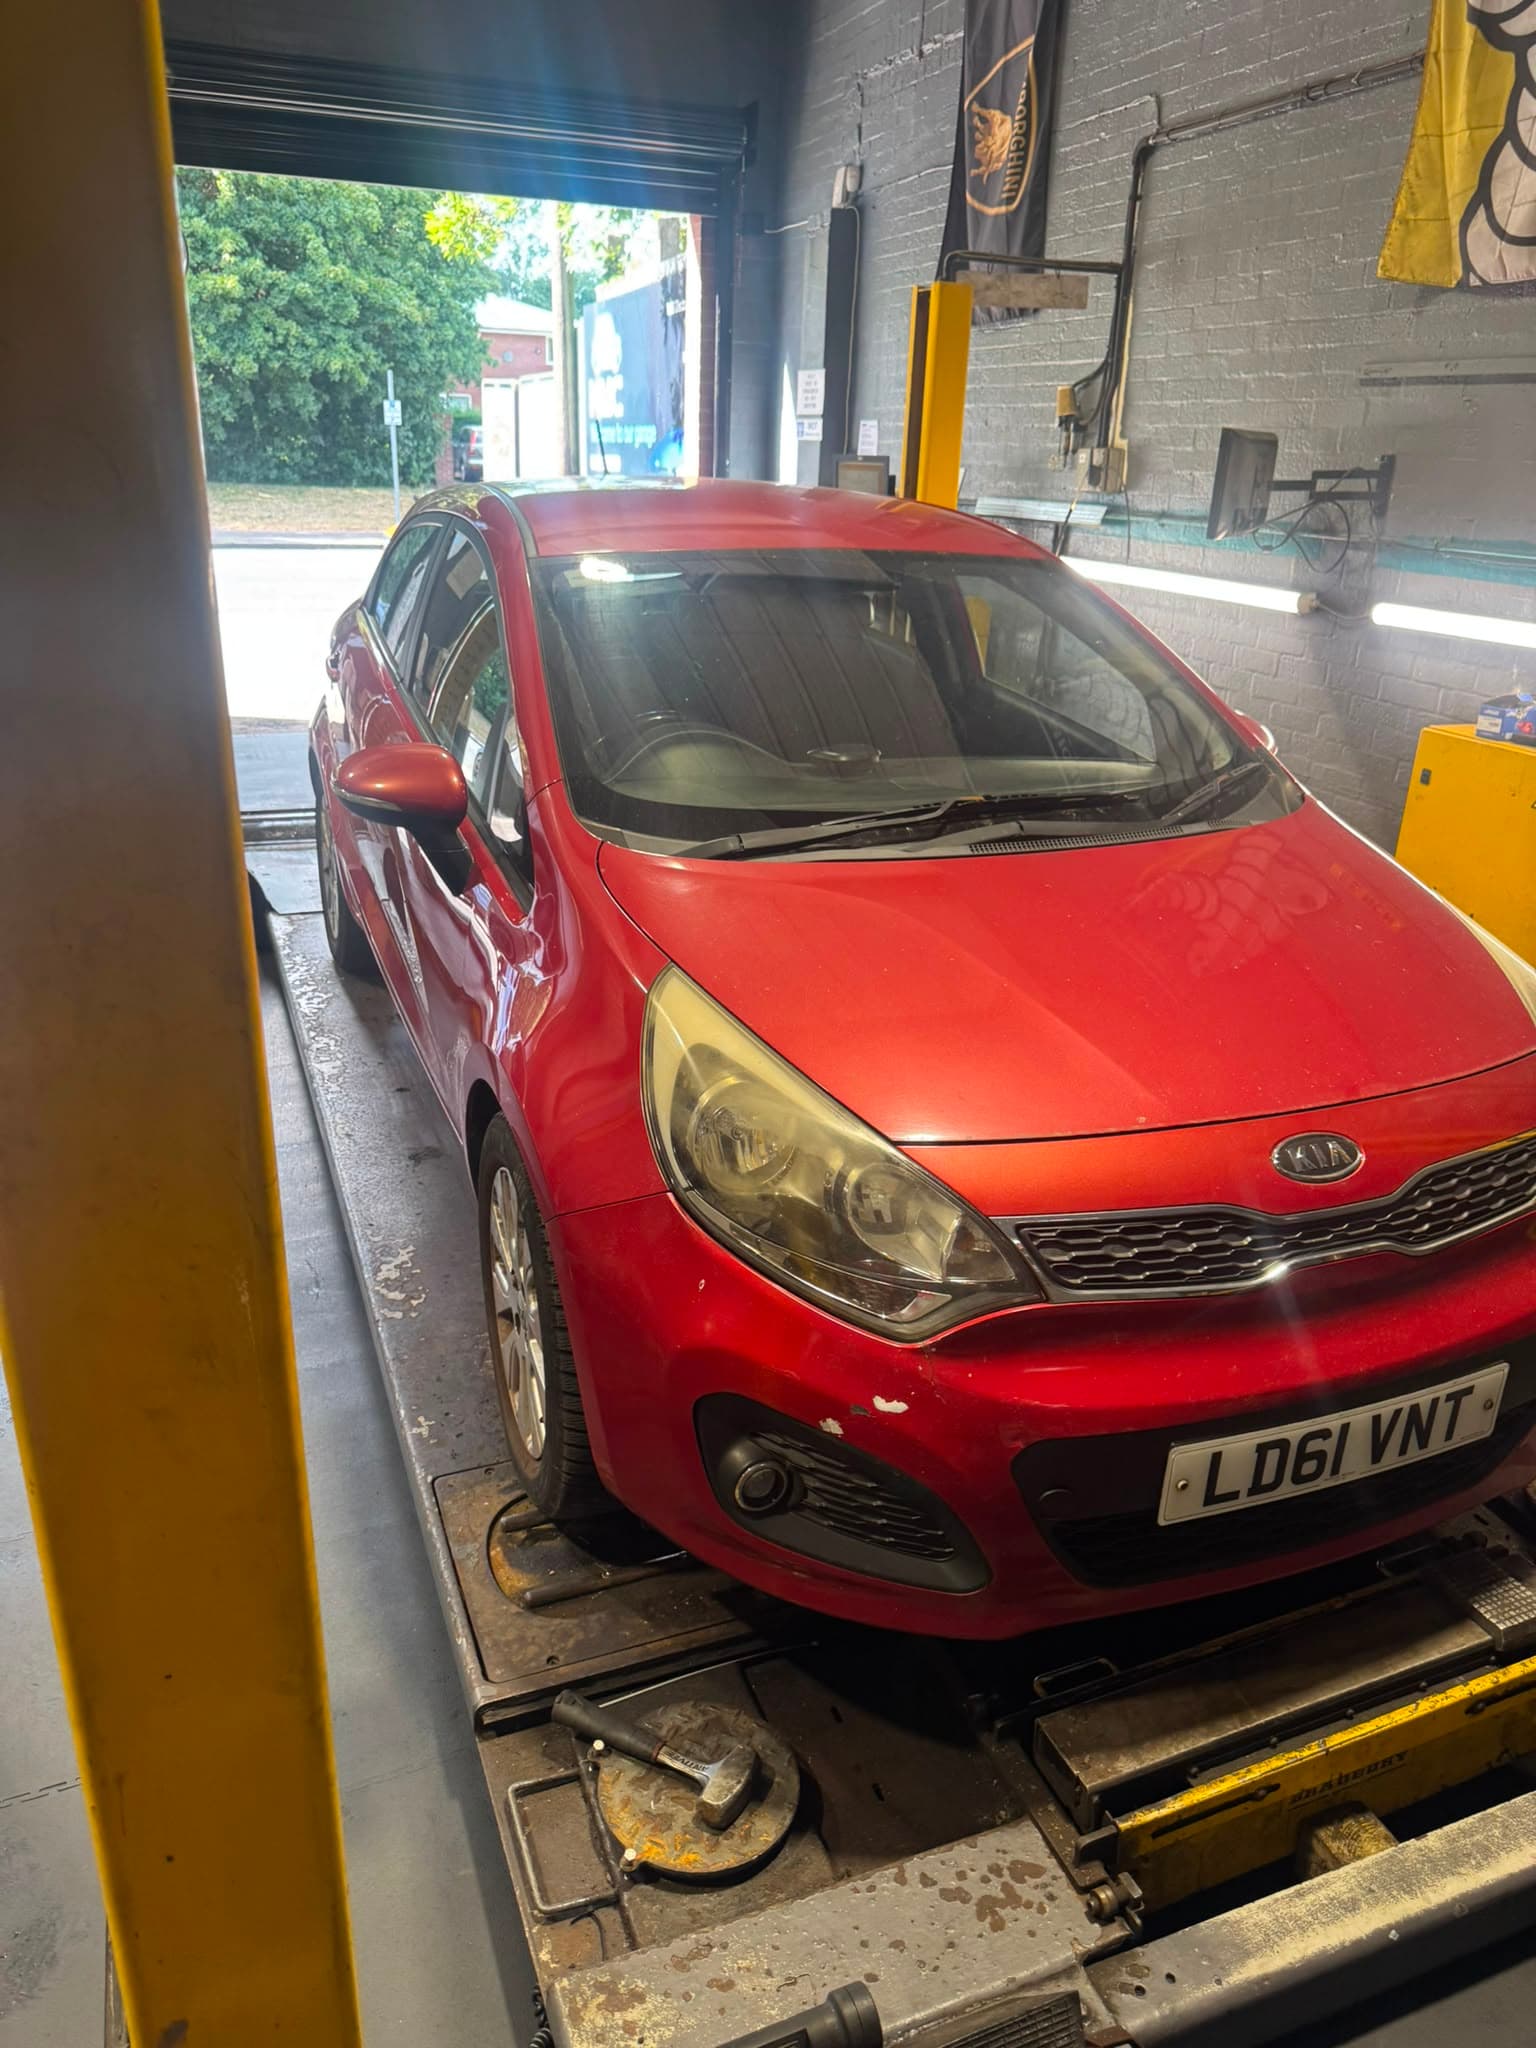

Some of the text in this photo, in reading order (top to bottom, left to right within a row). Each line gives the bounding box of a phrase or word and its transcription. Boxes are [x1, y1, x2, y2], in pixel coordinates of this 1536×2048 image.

[1285, 1140, 1353, 1173] KIA
[1203, 1385, 1475, 1507] LD61 VNT
